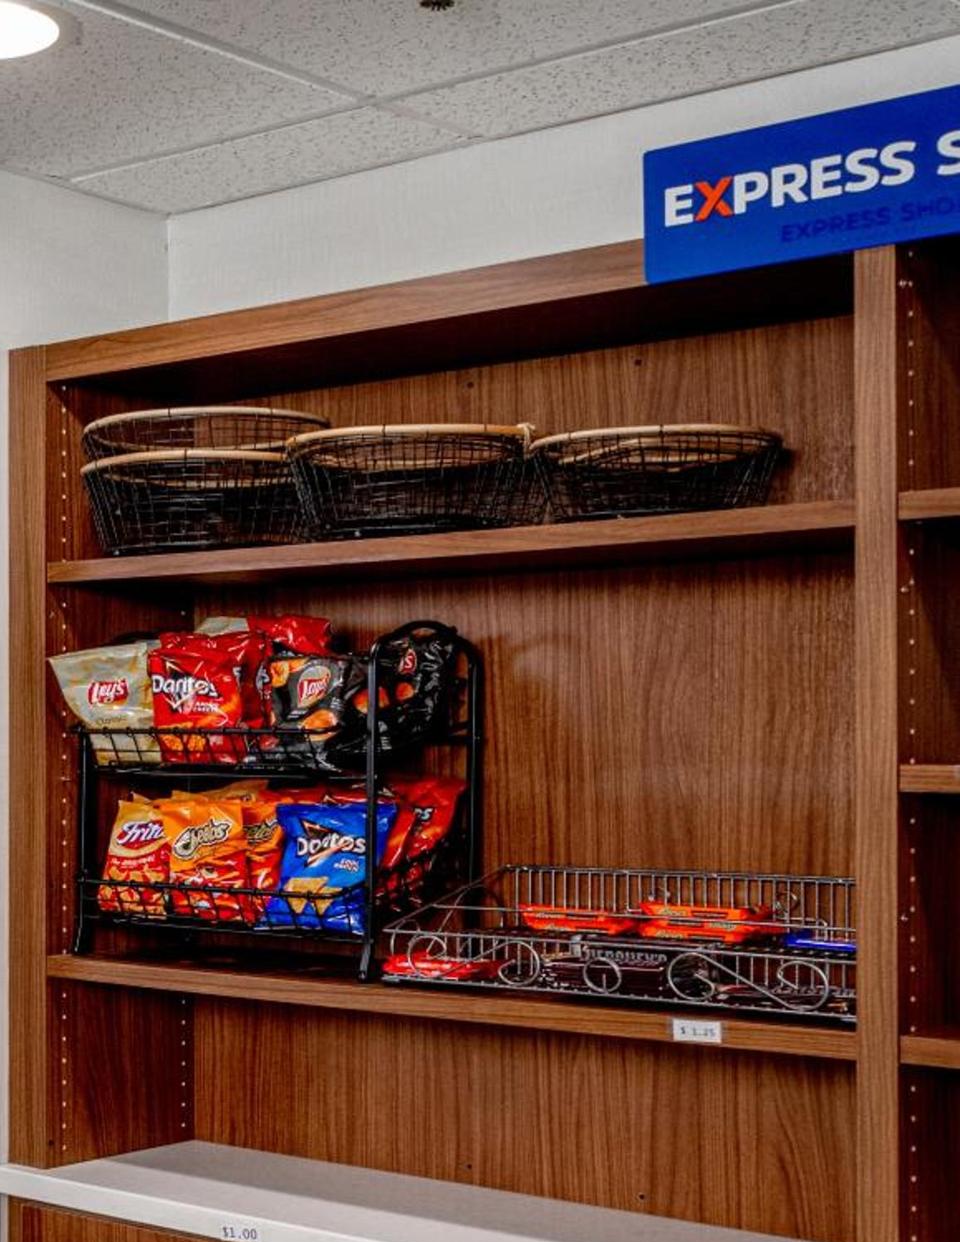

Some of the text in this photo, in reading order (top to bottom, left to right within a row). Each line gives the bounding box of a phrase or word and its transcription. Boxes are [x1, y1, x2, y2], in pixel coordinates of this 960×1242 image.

[663, 140, 917, 229] EXPRESS
[780, 195, 960, 243] EXPRESS SHO
[90, 680, 127, 704] Lay's
[151, 674, 219, 698] Doritos
[115, 821, 165, 846] Frit
[296, 831, 367, 857] Doritos
[222, 1226, 257, 1240] $1.00
